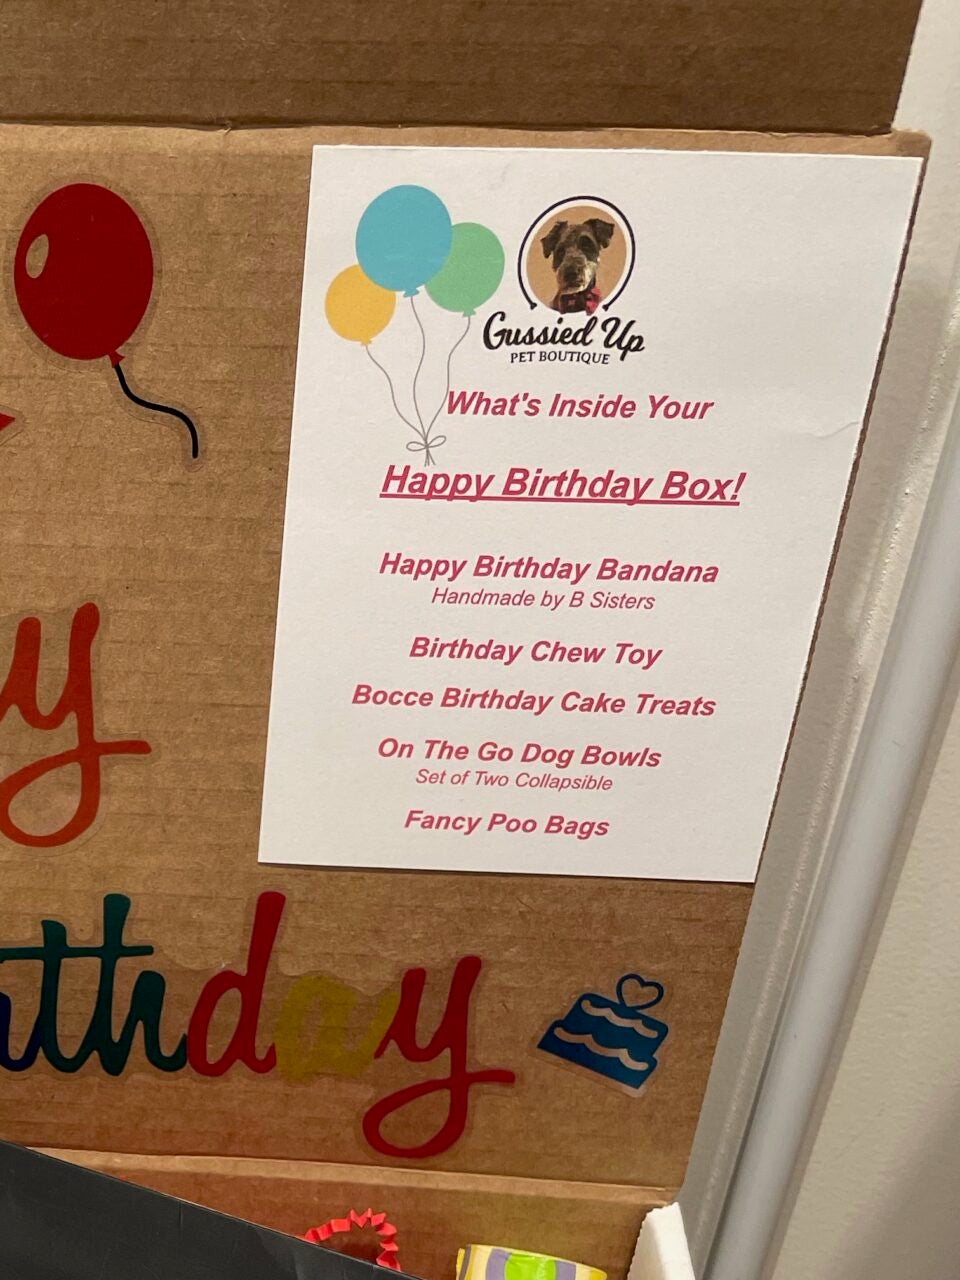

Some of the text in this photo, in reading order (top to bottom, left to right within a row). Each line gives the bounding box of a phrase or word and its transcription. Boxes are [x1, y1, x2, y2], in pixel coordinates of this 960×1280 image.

[482, 311, 646, 362] Gussied Up
[510, 351, 611, 366] PET BOUTIQUE
[446, 390, 714, 421] What's Inside Your
[382, 464, 746, 506] Happy Birthday Box!
[379, 551, 720, 585] Happy Birthday Bandana
[431, 587, 656, 612] Handmade by B Sisters
[409, 635, 663, 670] Birthday Chew Toy
[351, 684, 717, 718] Bocce Birthday Cake Treats
[377, 737, 662, 769] On The Go Dog Bowls
[415, 767, 614, 792] Set of Two Collapsible
[404, 809, 610, 841] Fancy Poo Bags
